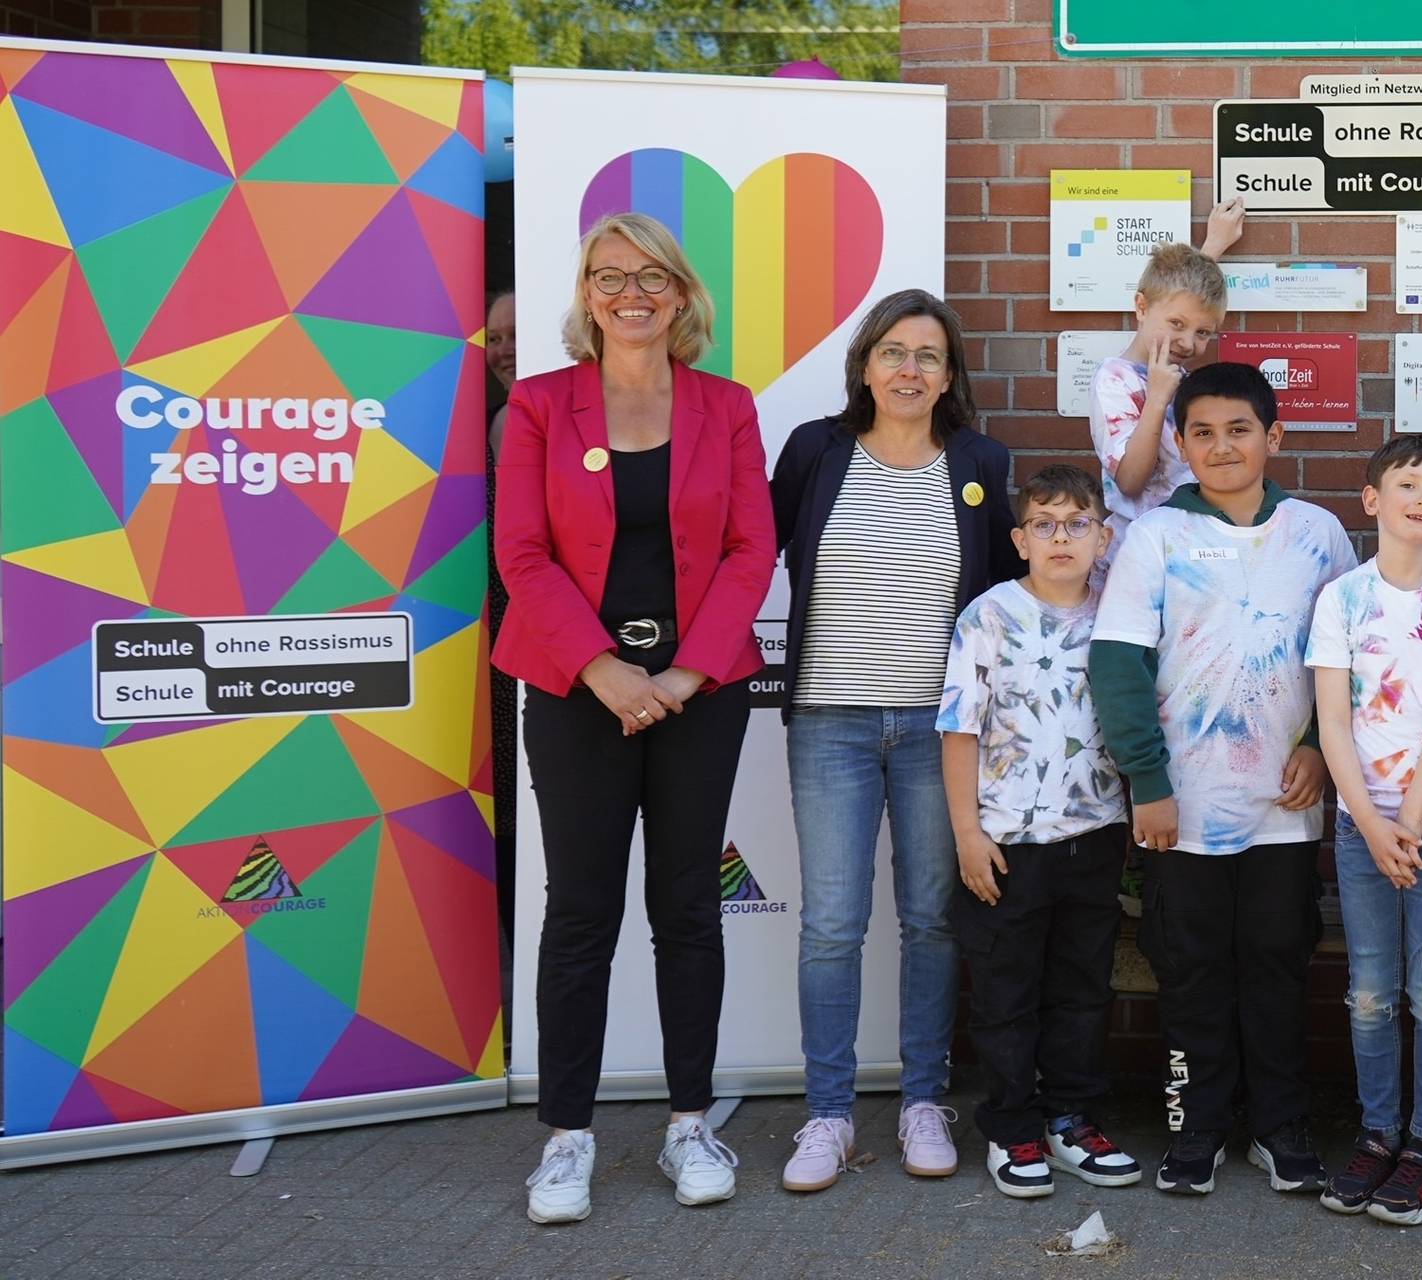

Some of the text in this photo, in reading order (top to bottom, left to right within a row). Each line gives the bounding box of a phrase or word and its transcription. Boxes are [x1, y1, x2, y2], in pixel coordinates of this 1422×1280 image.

[1310, 84, 1361, 97] Mitglied
[1365, 84, 1380, 94] im
[1235, 123, 1313, 143] Schule
[1335, 123, 1391, 141] ohne
[1236, 174, 1312, 192] Schule
[1337, 173, 1373, 192] mit
[1068, 187, 1119, 195] Wir sind eine
[1116, 218, 1153, 230] START
[1116, 231, 1174, 243] CHANCEN
[1291, 398, 1315, 408] leben
[1322, 399, 1349, 409] lernen
[115, 384, 386, 440] Courage
[150, 439, 354, 495] zeigen
[114, 633, 393, 658] Schule ohne Rassismus
[755, 636, 786, 651] Ras
[116, 679, 355, 702] Schule mit Courage
[748, 680, 785, 693] our
[721, 902, 787, 914] COURAGE
